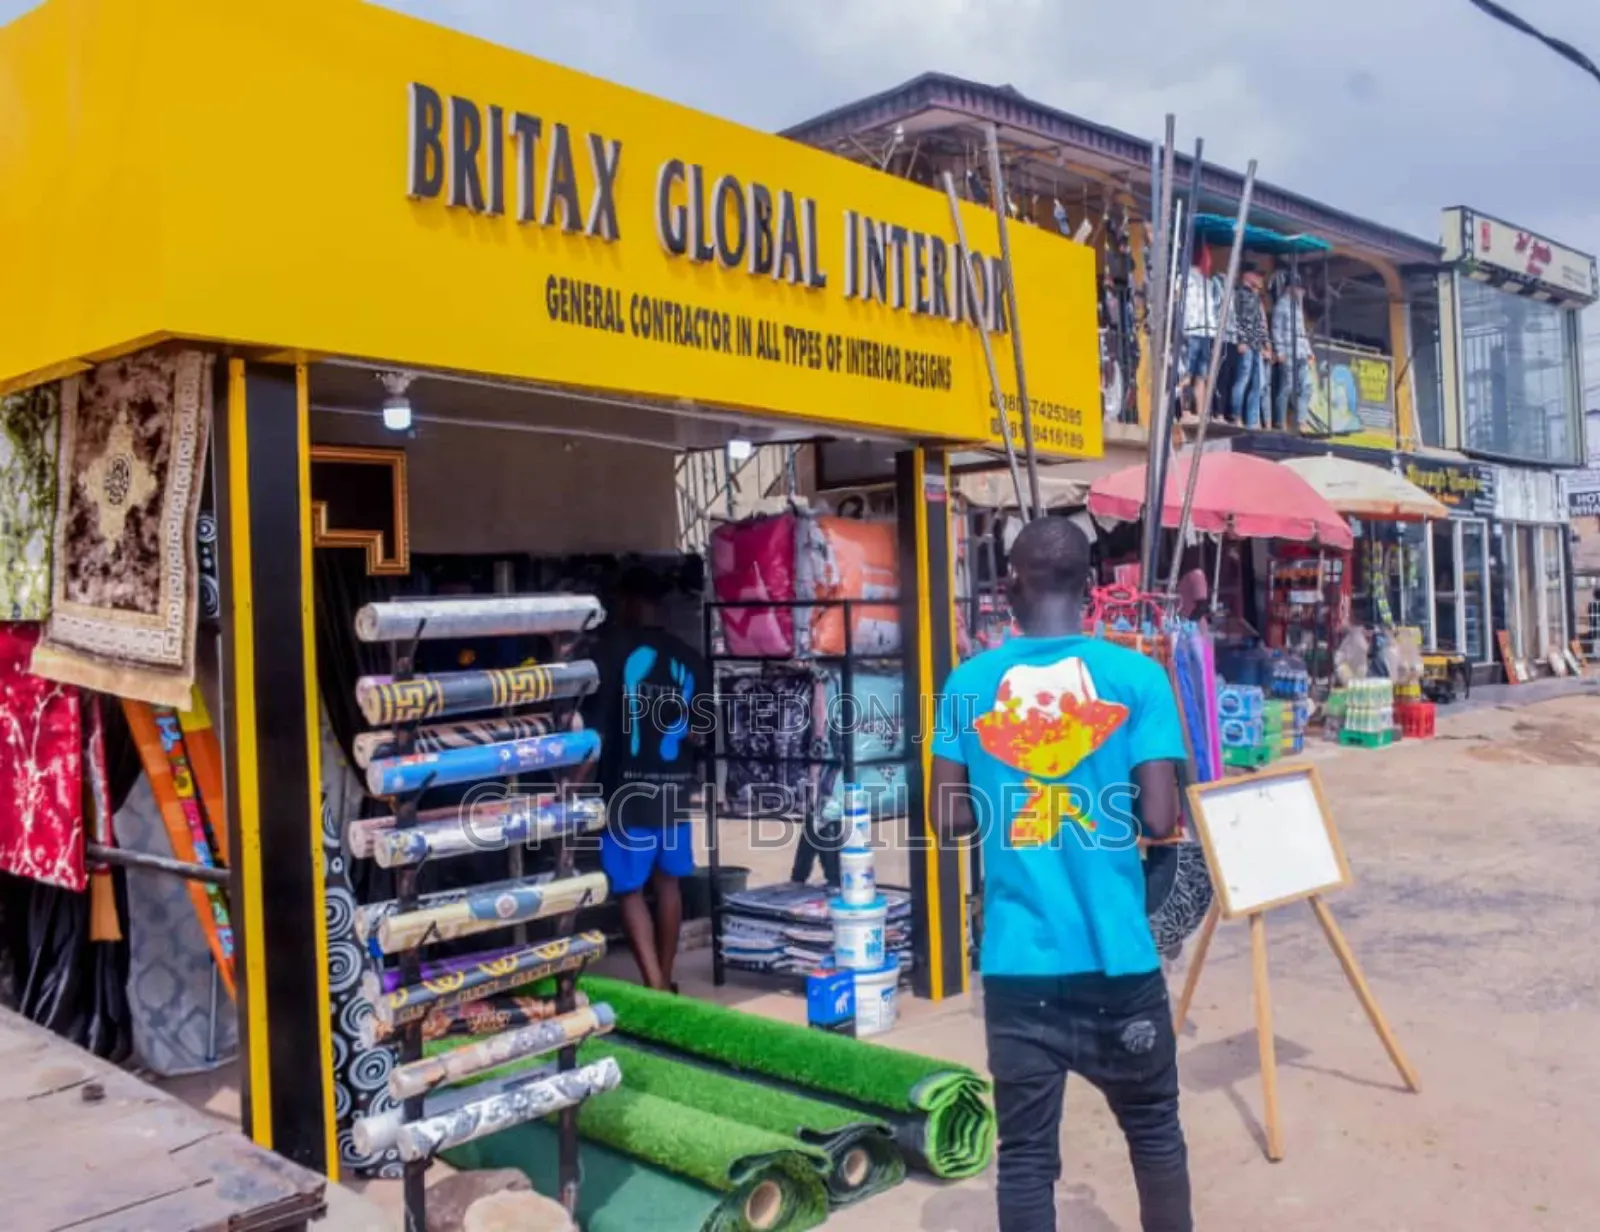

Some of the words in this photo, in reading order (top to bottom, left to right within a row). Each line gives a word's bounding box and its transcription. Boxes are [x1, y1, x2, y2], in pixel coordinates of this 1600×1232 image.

[407, 82, 621, 241] BRITAX
[656, 158, 826, 288] GLOBAL
[843, 209, 1010, 335] INTERIOR
[545, 273, 625, 334] GENERAL
[630, 291, 732, 355] CONTRACTOR
[736, 314, 752, 357] IN
[757, 318, 781, 362] ALL
[784, 324, 822, 371] TYPES
[826, 334, 843, 373] OF
[846, 337, 902, 385] INTERIOR
[905, 348, 953, 393] DESIGNS
